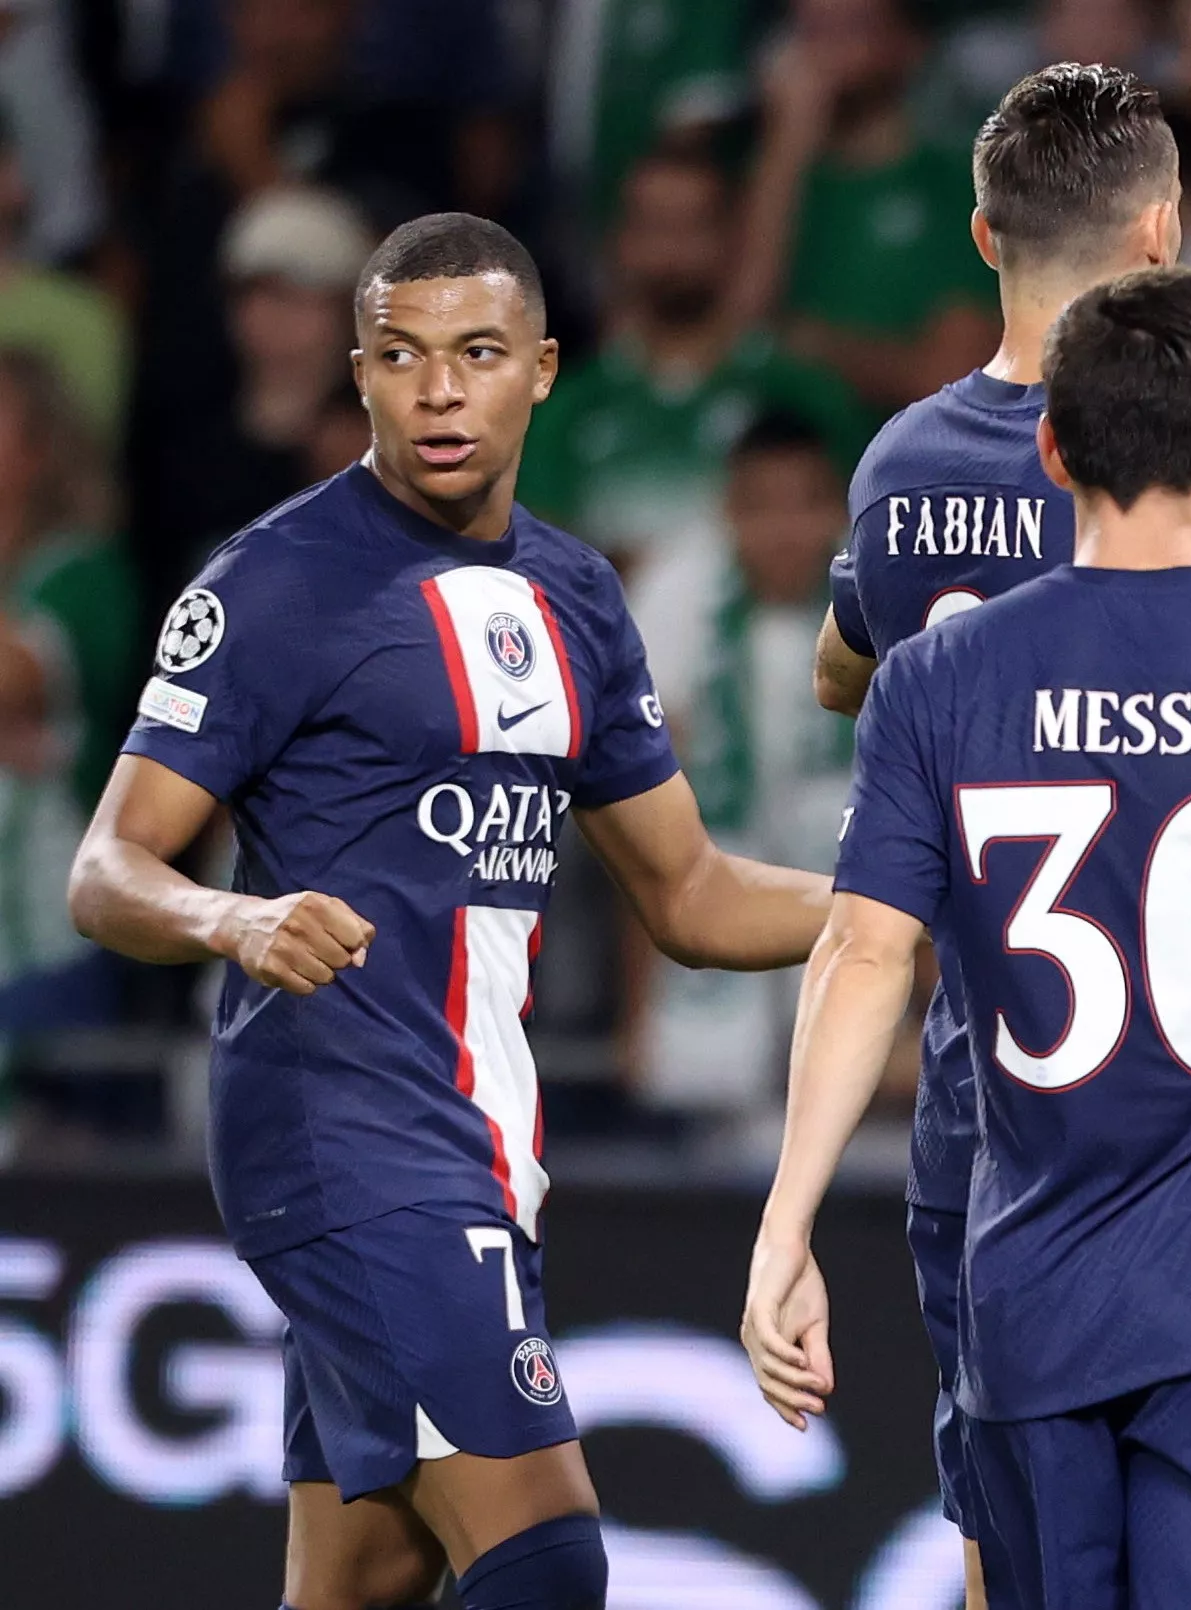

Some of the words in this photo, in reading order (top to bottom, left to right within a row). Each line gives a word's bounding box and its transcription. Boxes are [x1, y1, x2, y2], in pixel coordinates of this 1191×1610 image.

[886, 494, 1046, 560] FABIAN
[462, 1227, 528, 1332] 7
[516, 1340, 549, 1362] PARIS
